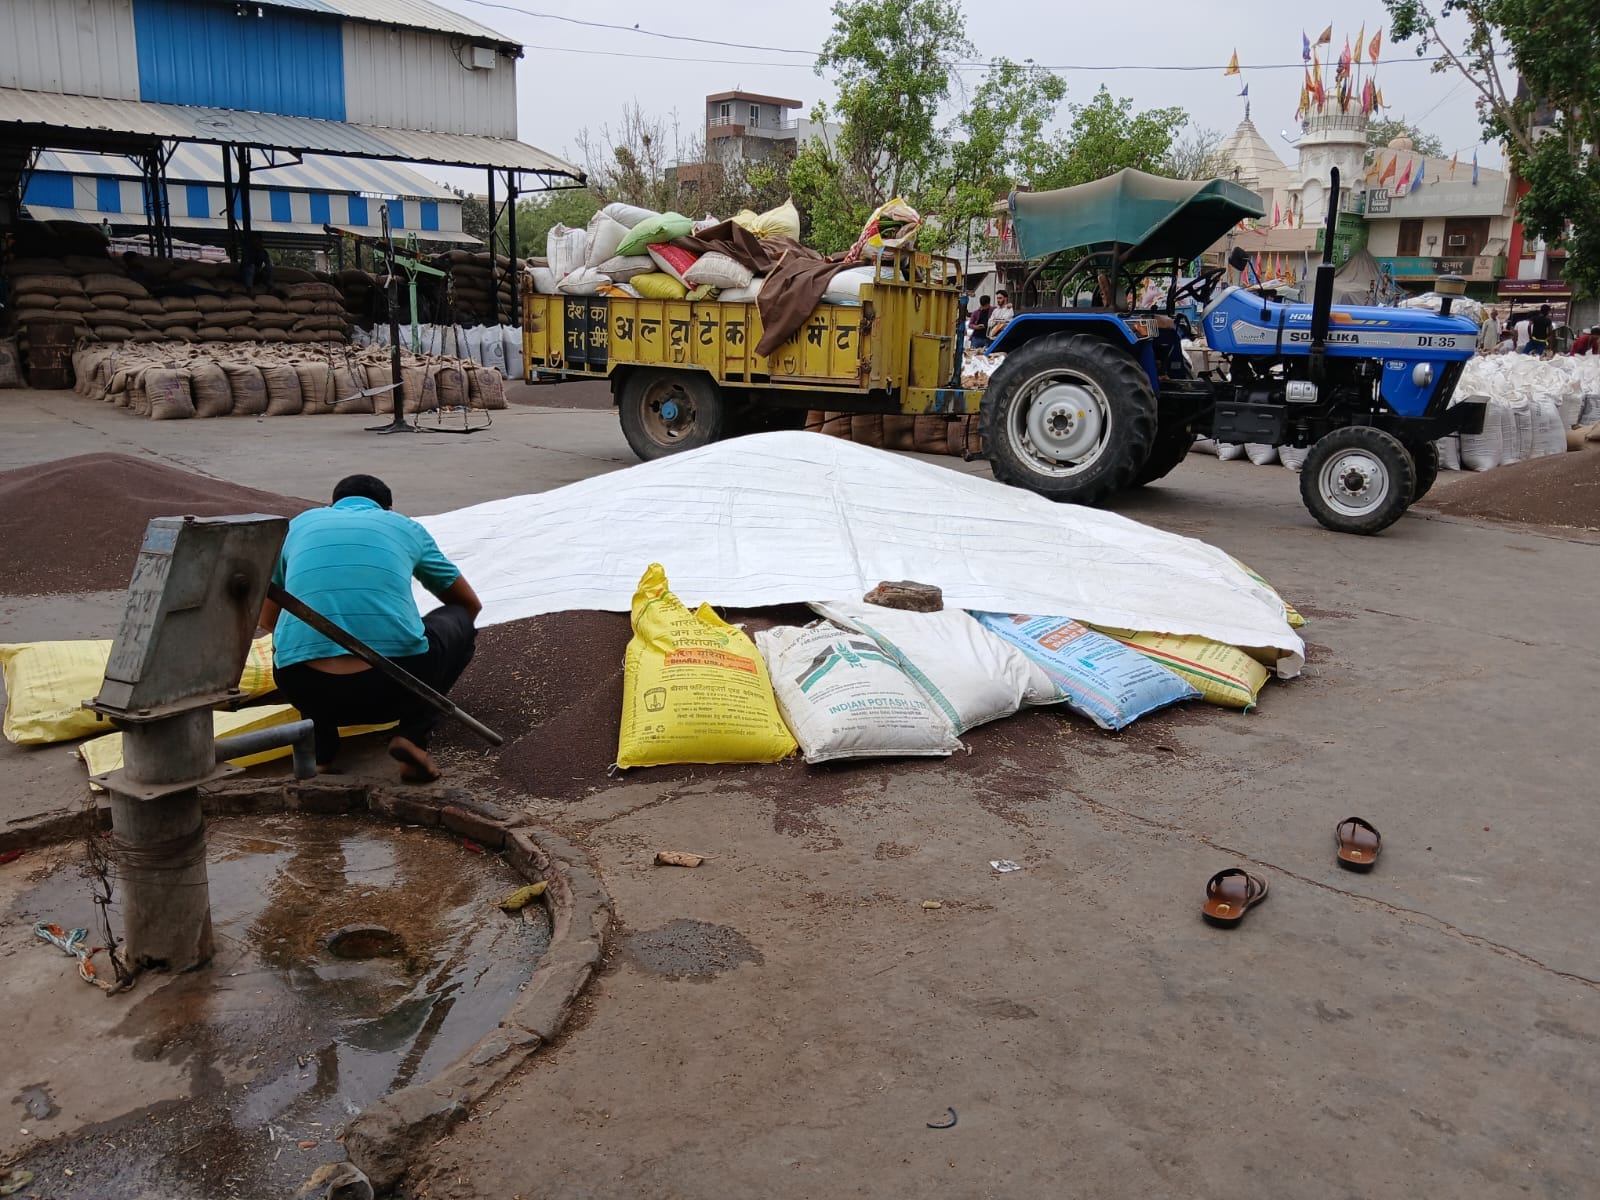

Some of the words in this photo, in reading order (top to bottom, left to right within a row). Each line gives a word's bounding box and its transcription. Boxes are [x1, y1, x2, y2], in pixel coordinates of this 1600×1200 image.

[567, 301, 585, 320] देश
[590, 306, 608, 323] का
[1290, 332, 1360, 344] SOLIKA
[829, 699, 866, 714] INDIAN
[868, 698, 908, 708] POTASH
